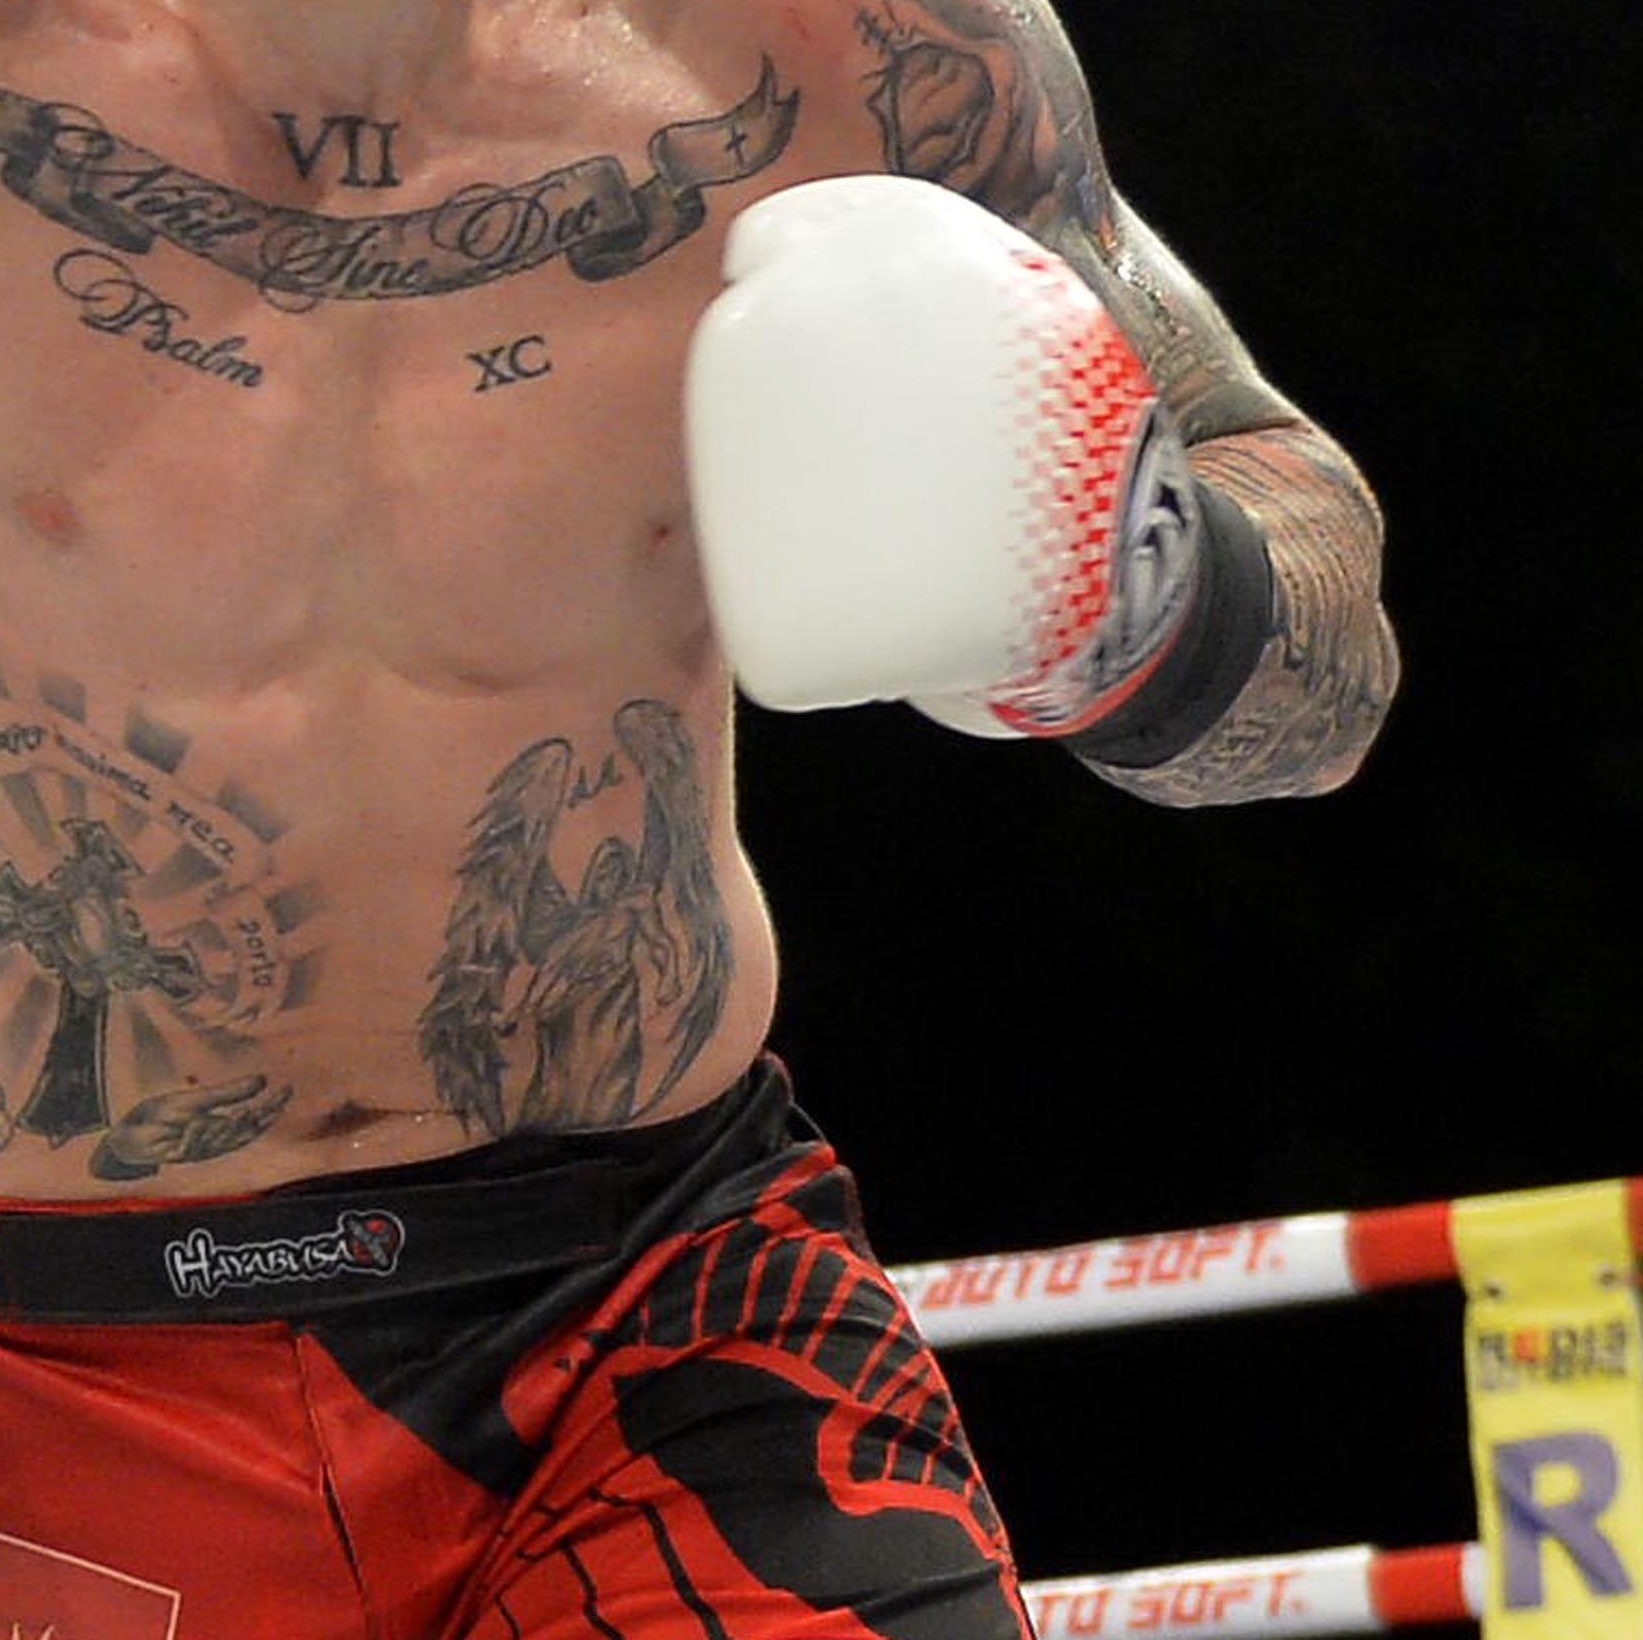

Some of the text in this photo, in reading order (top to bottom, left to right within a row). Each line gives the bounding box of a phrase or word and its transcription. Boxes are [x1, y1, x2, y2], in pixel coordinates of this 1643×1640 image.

[271, 111, 401, 189] VII
[53, 246, 553, 392] Psalm XC
